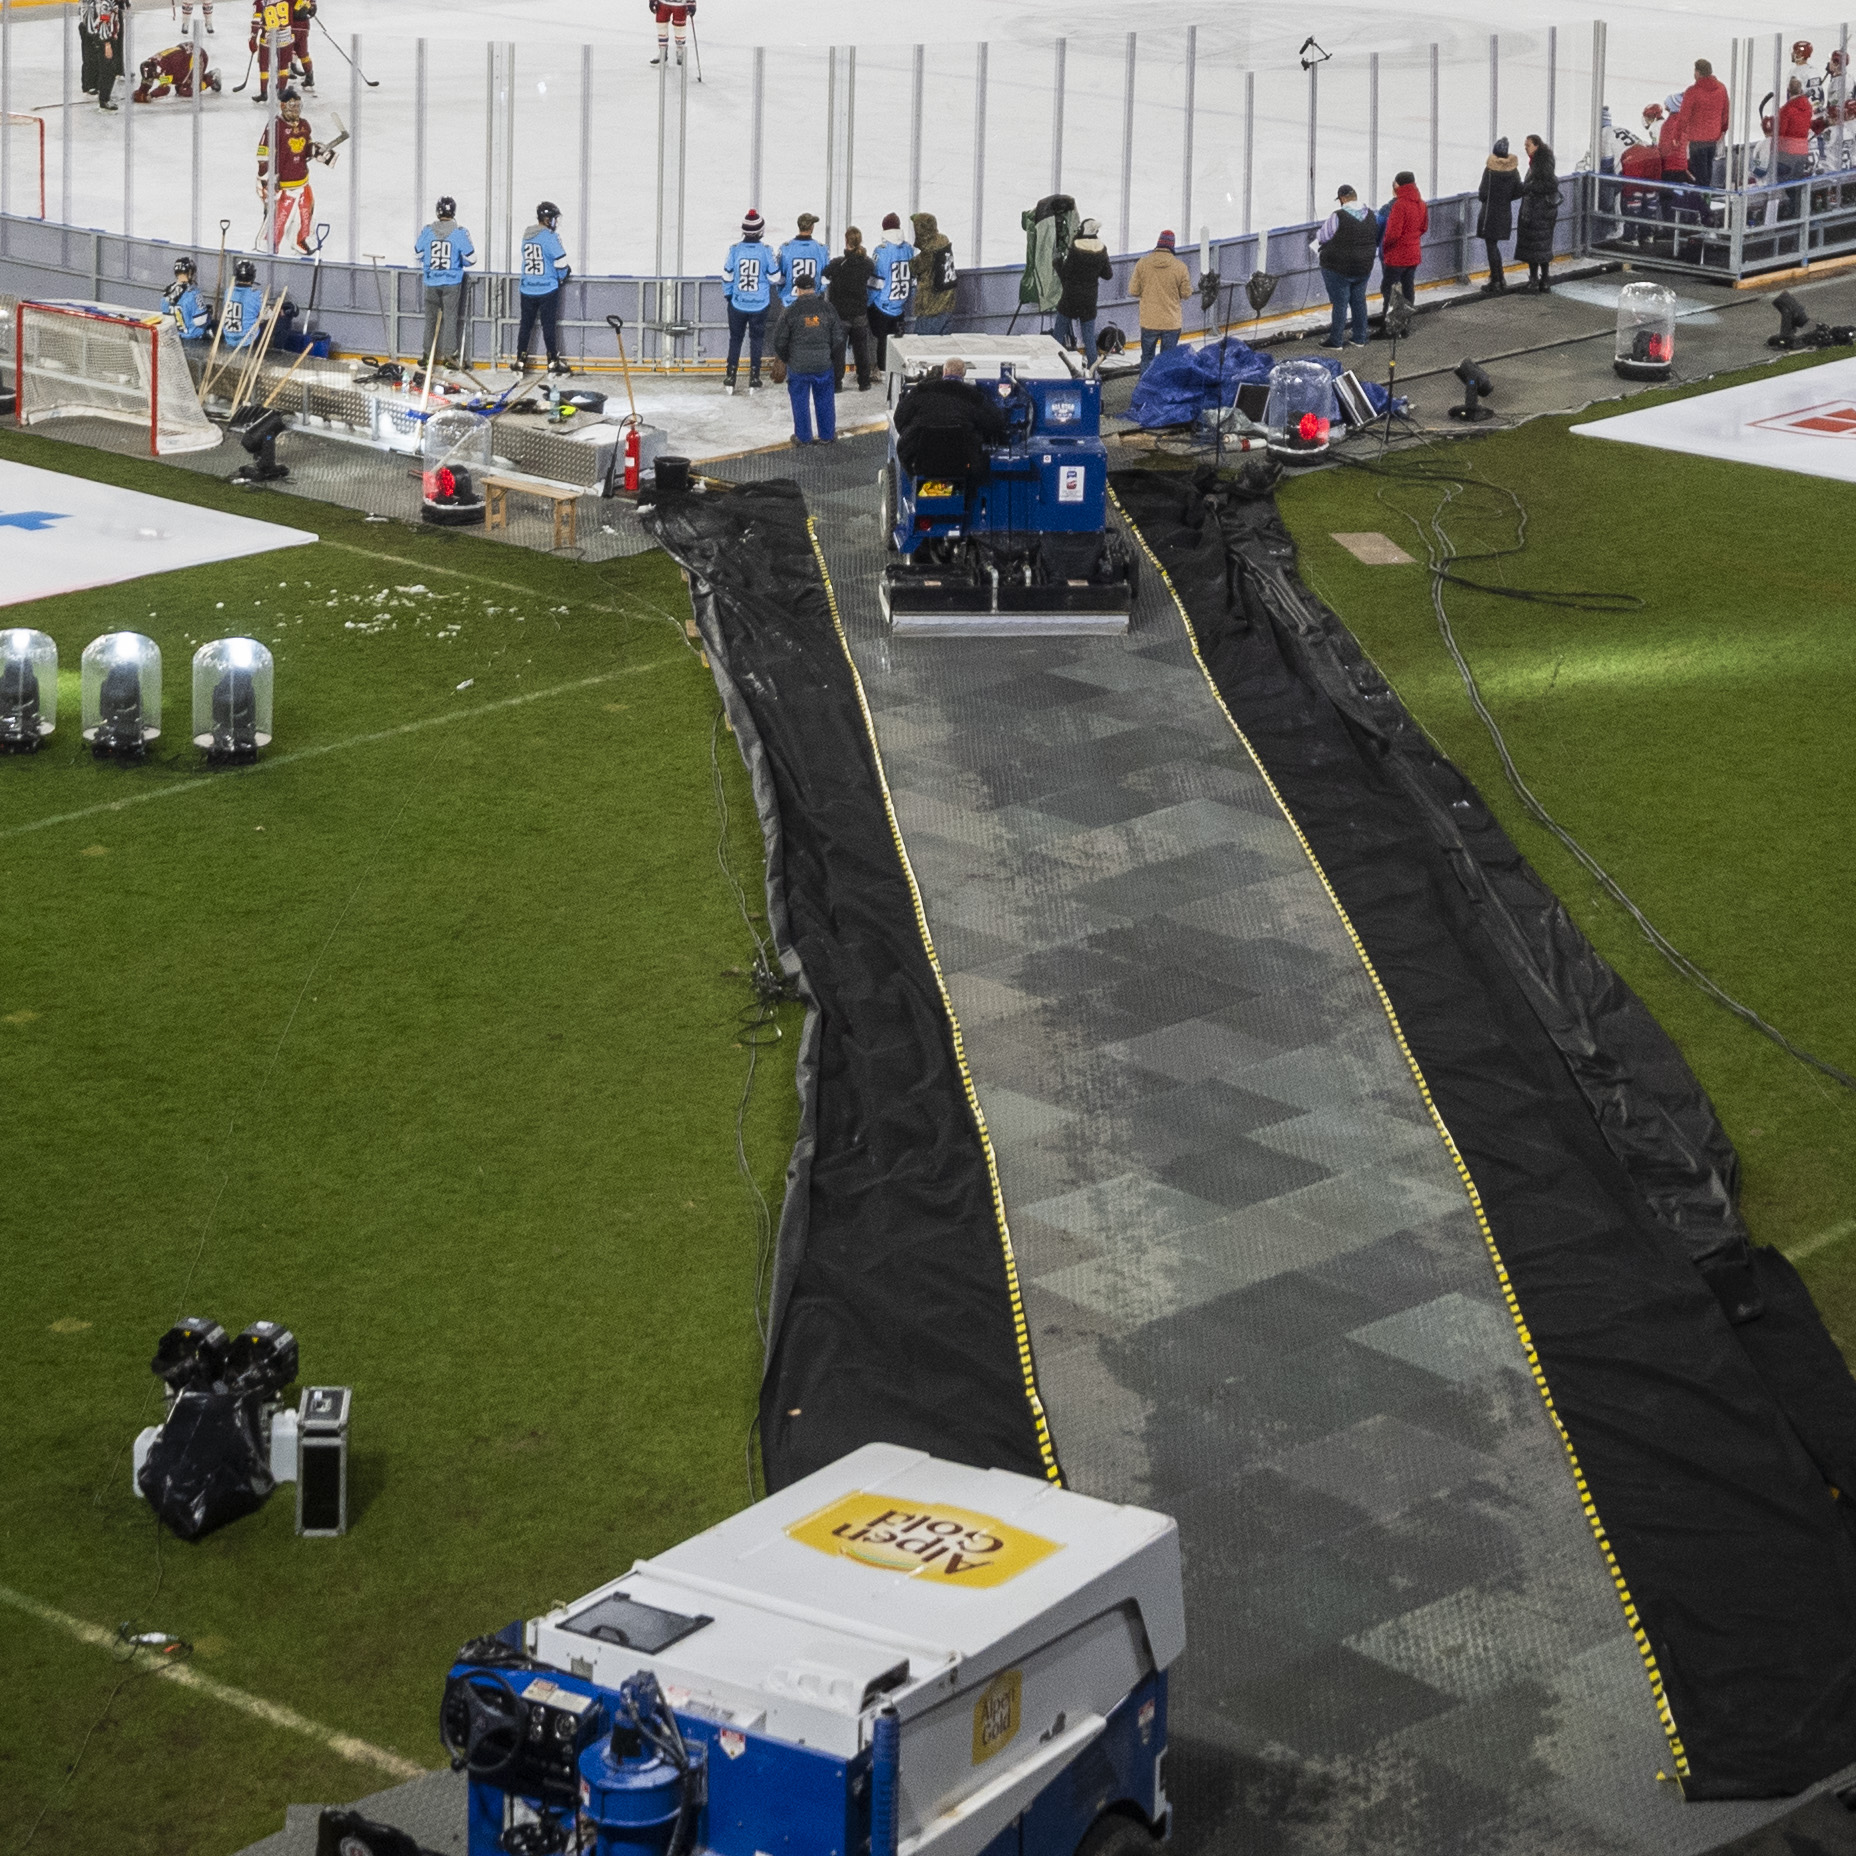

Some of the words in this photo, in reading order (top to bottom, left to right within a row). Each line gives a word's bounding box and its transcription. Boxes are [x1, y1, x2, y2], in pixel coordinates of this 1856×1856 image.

[263, 1, 289, 31] 89
[430, 240, 451, 258] 20
[524, 243, 542, 261] 20
[524, 259, 543, 276] 23
[739, 259, 760, 276] 20
[792, 258, 816, 278] 20
[891, 261, 910, 281] 20
[738, 275, 759, 292] 23
[889, 280, 909, 300] 23
[866, 1509, 1004, 1554] Gold
[832, 1522, 994, 1575] Alpen
